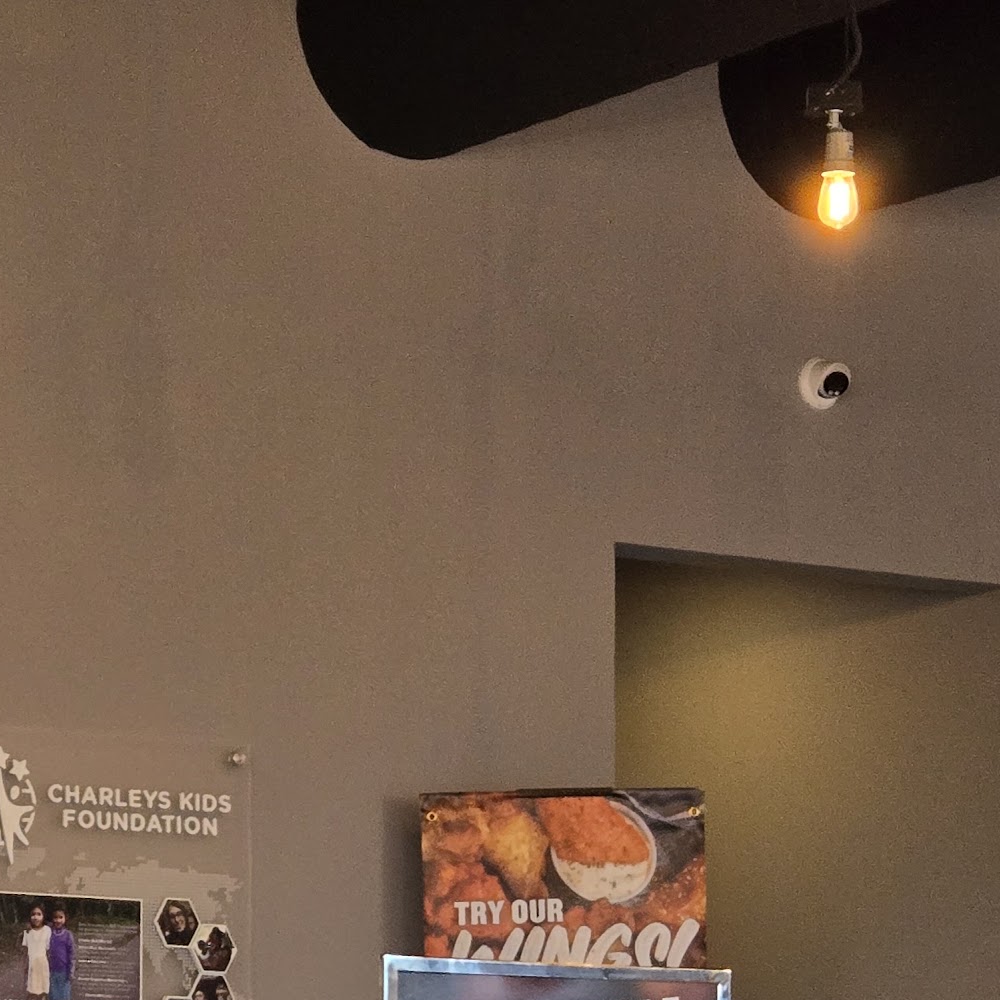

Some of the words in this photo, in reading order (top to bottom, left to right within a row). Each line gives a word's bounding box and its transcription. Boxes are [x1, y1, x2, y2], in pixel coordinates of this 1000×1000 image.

[48, 783, 170, 809] CHARLEYS
[179, 792, 232, 813] KIDS
[62, 809, 218, 836] FOUNDATION
[454, 900, 504, 926] TRY
[511, 898, 564, 925] OUR
